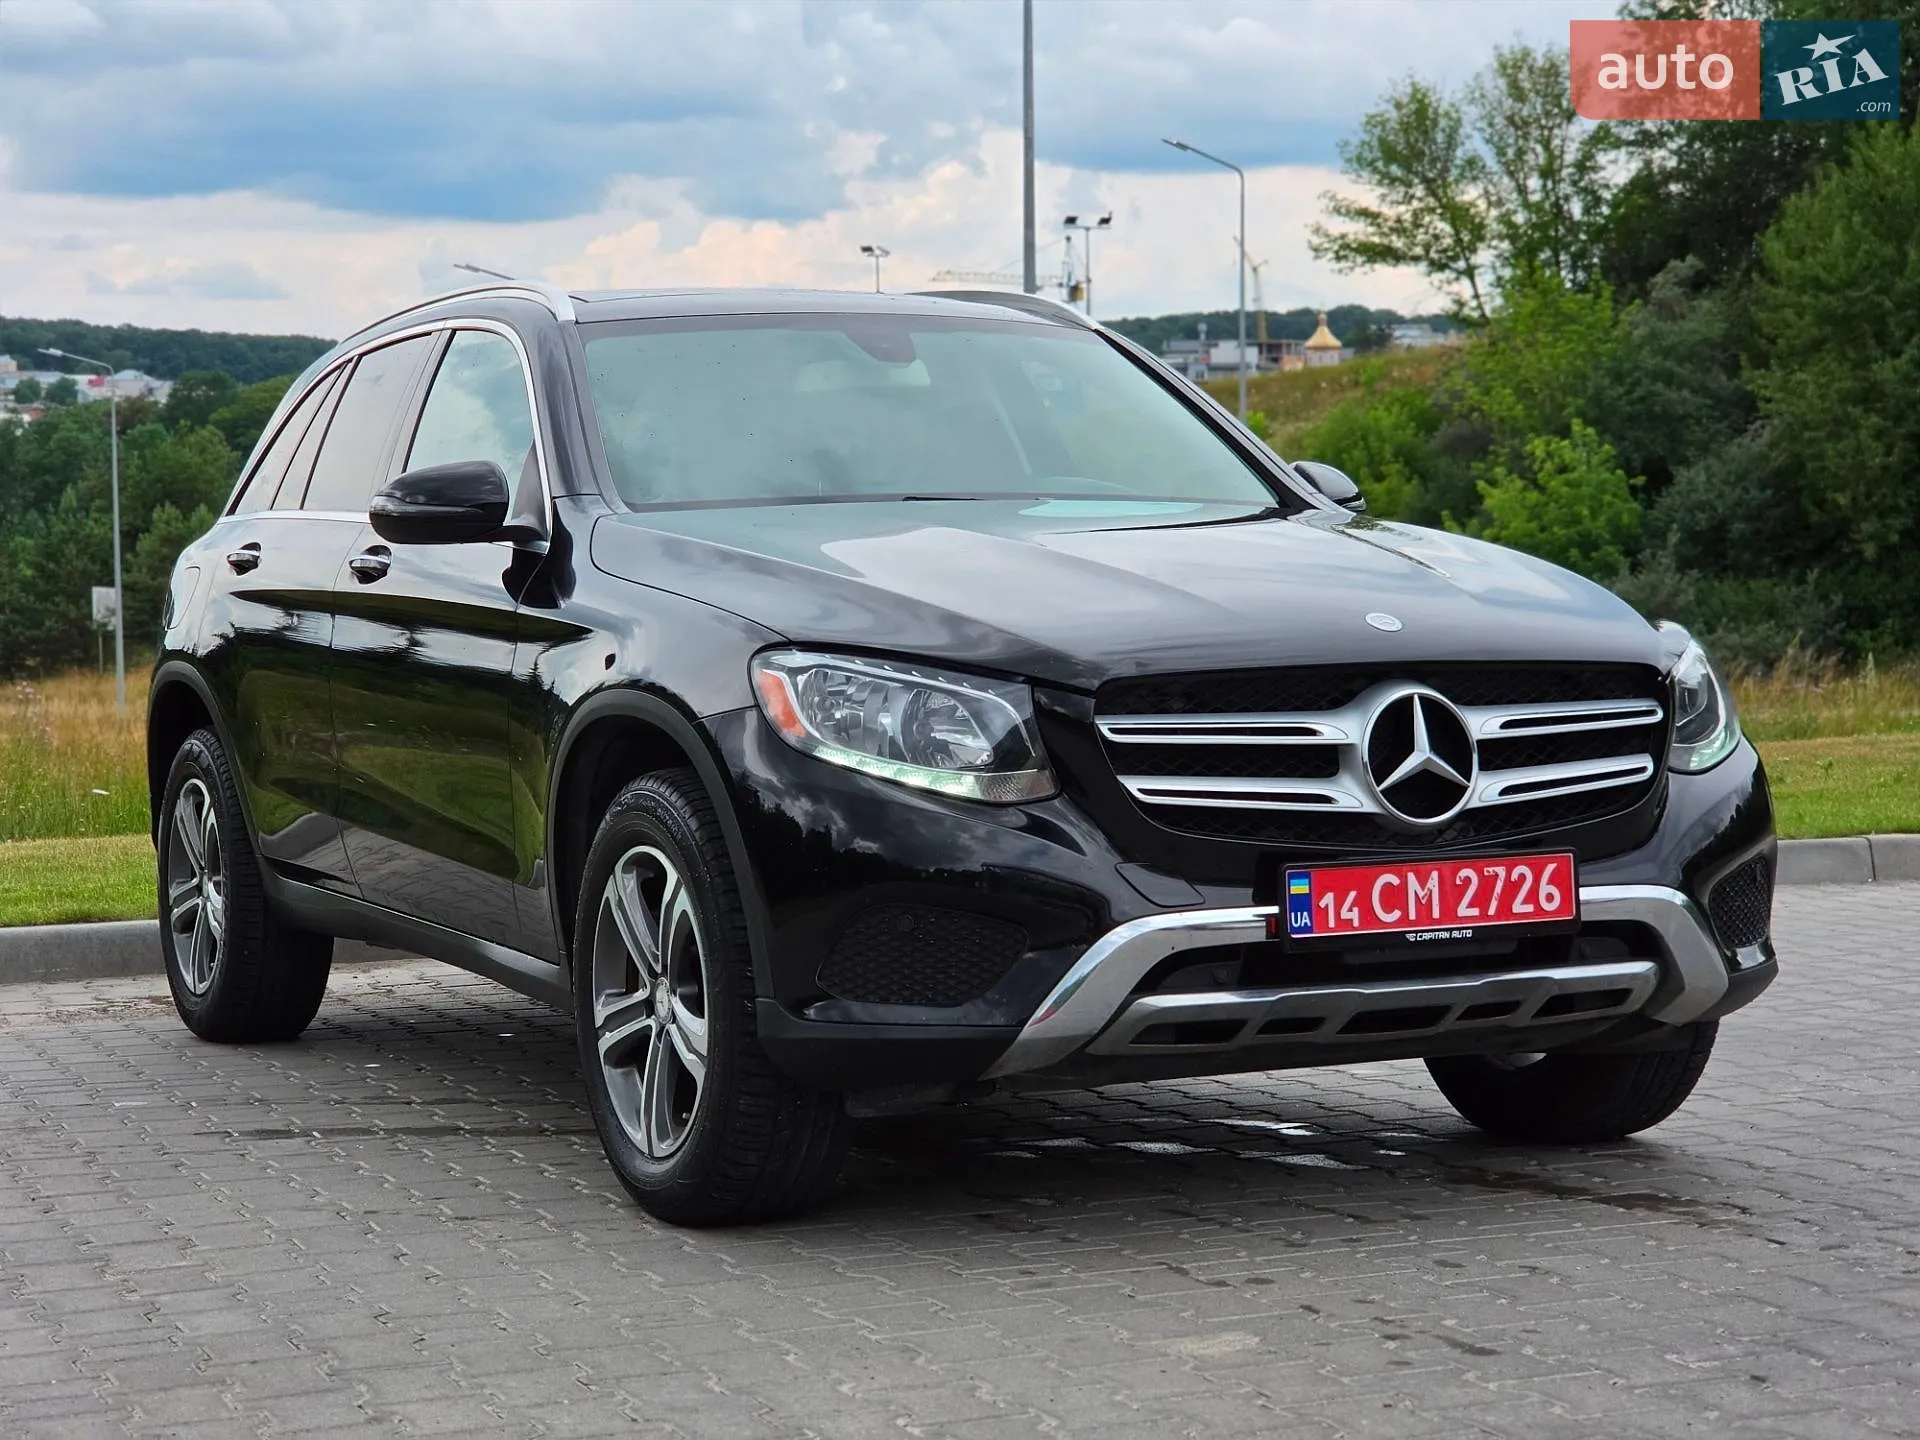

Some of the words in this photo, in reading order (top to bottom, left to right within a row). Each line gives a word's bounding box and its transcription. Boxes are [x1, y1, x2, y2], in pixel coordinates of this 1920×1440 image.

[1318, 890, 1360, 928] 14
[1371, 870, 1441, 923] CM
[1455, 863, 1562, 917] 2726
[1291, 911, 1312, 928] UA
[1416, 931, 1450, 941] CAPITAN
[1451, 929, 1473, 938] AUTO
